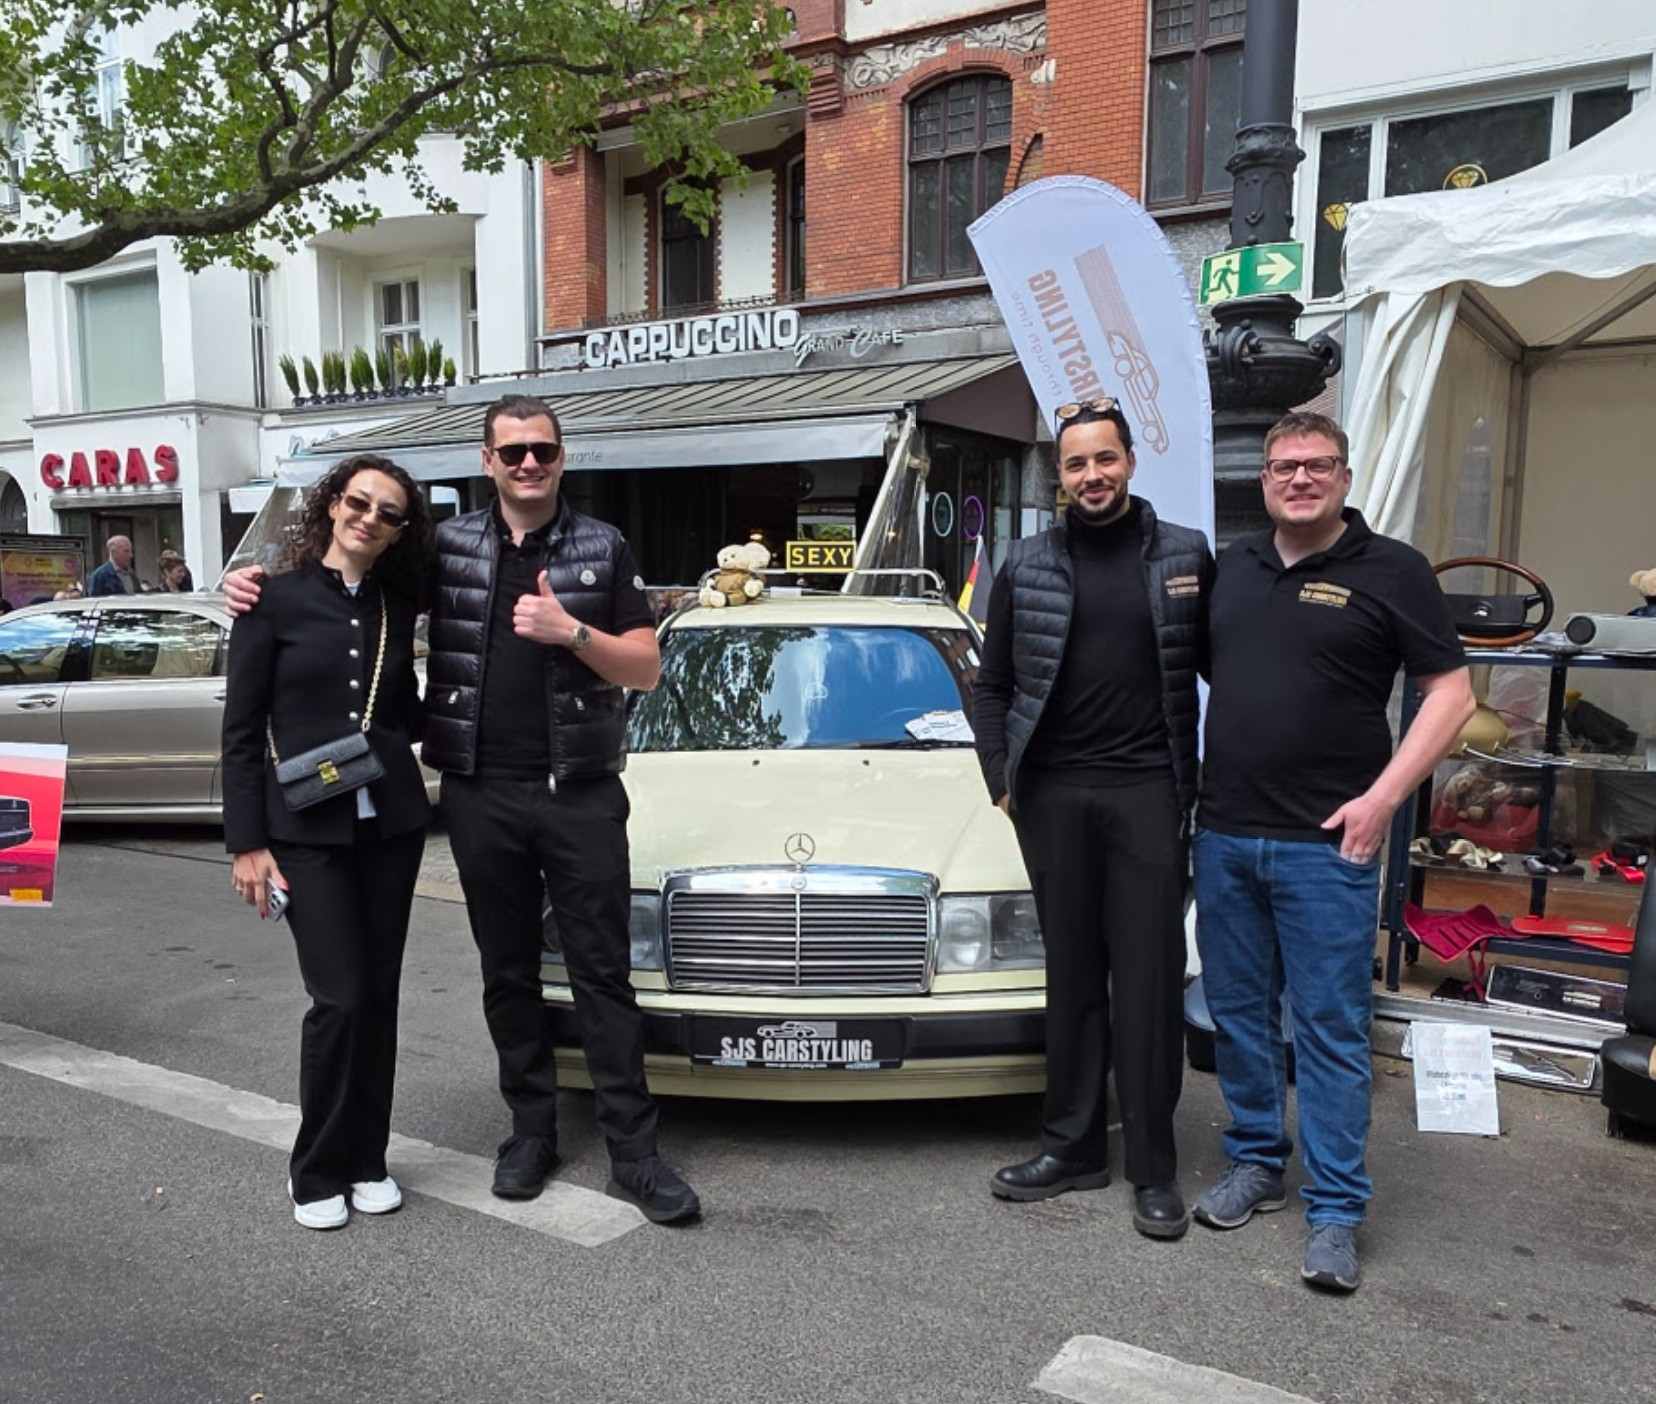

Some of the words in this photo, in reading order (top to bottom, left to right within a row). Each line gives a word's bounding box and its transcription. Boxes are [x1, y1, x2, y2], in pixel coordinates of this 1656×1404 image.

[586, 308, 799, 368] CAPPUCCINO
[40, 444, 180, 490] CARAS
[791, 547, 852, 566] SEXY
[720, 1036, 756, 1061] SJS
[762, 1038, 873, 1062] CARSTYLING
